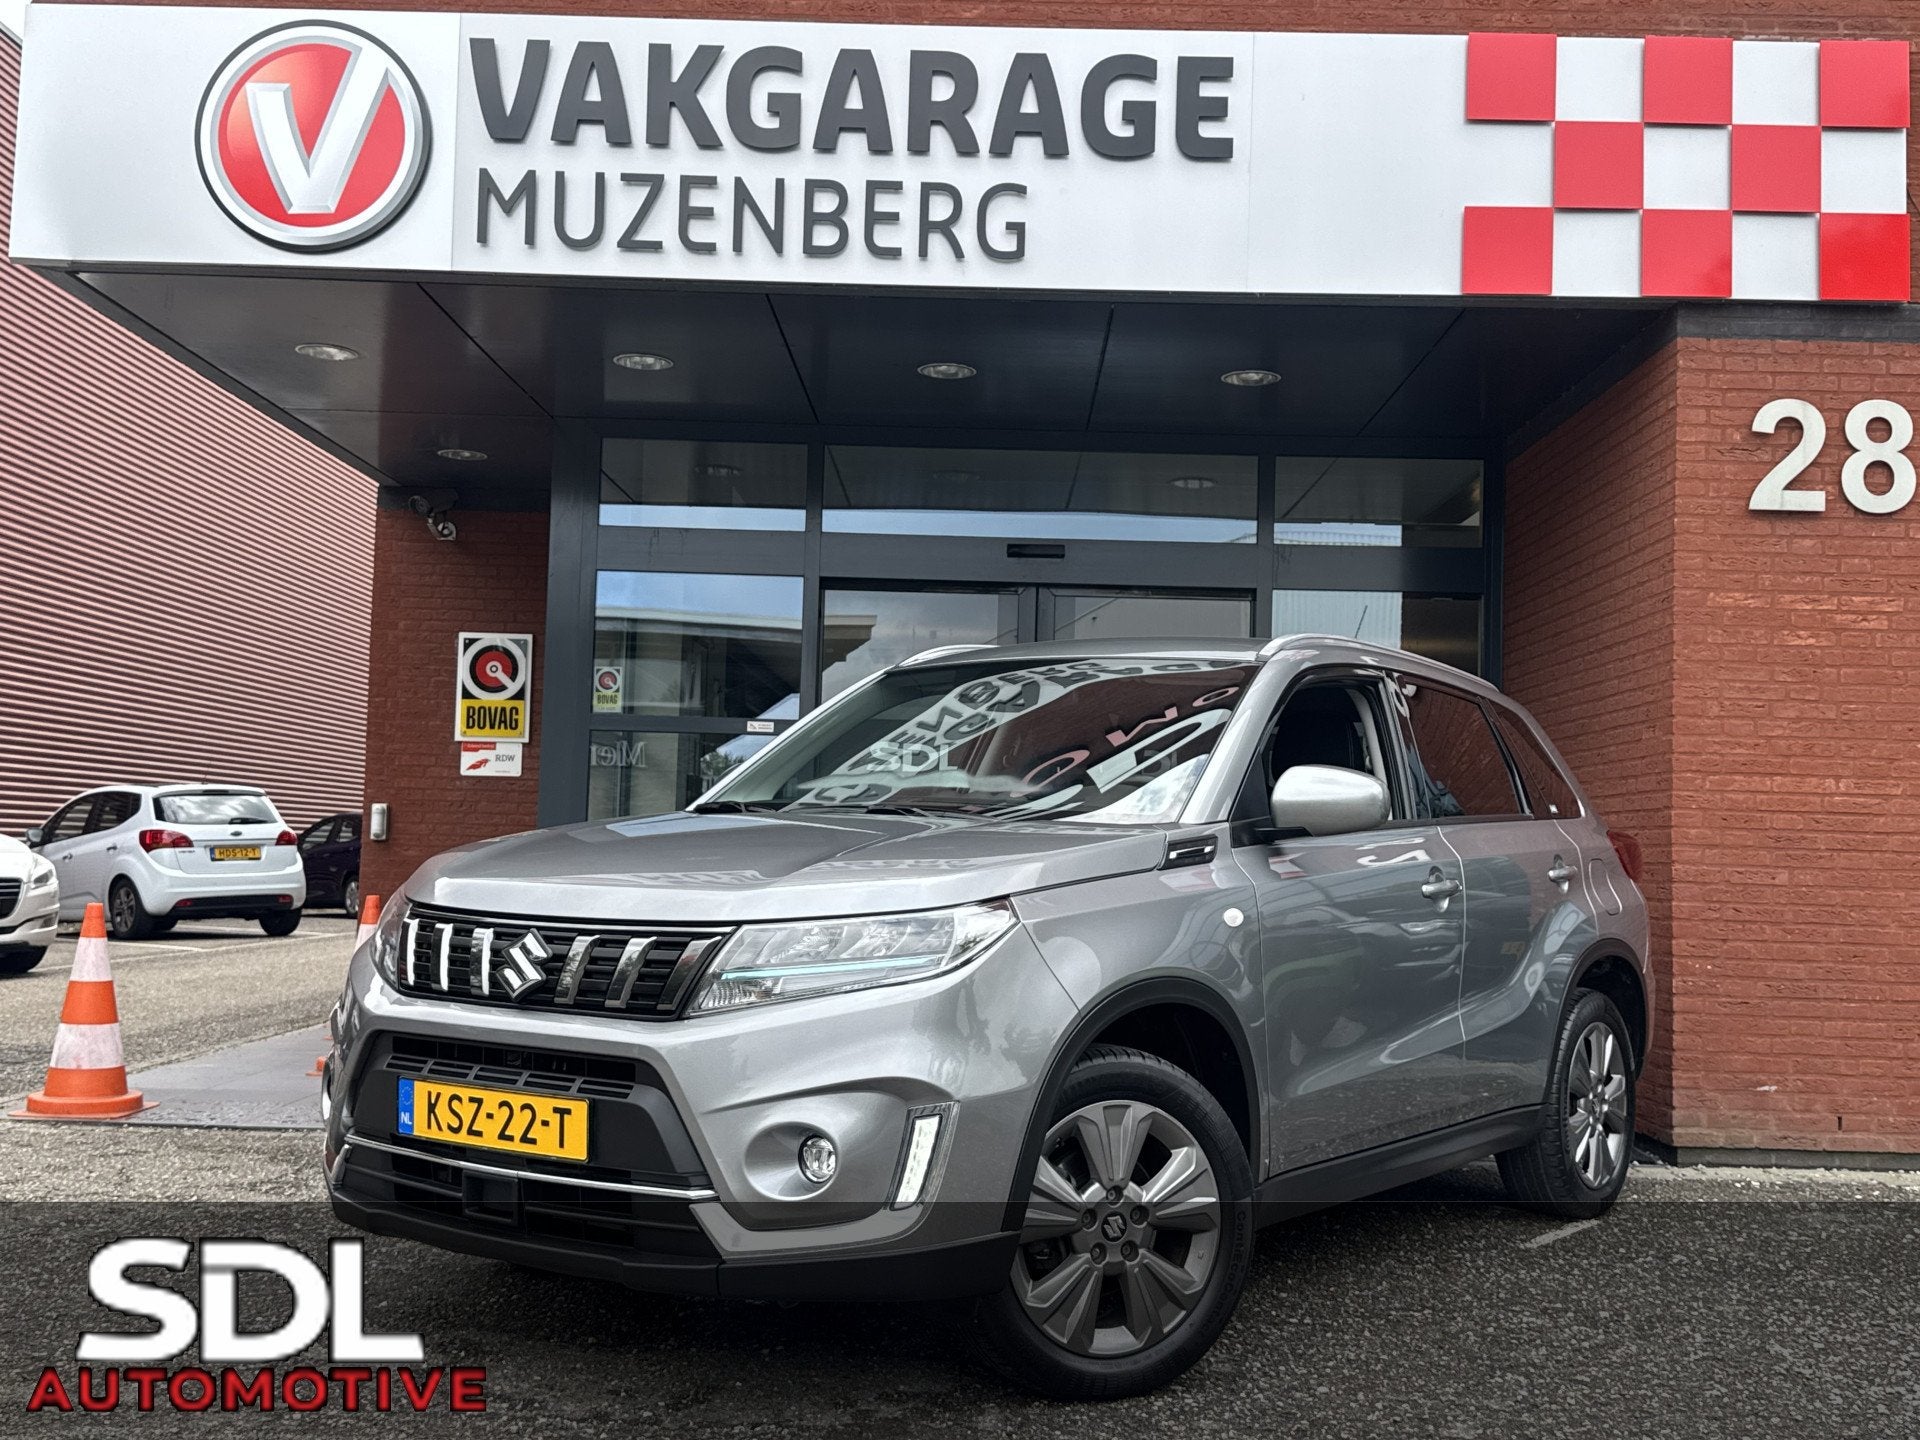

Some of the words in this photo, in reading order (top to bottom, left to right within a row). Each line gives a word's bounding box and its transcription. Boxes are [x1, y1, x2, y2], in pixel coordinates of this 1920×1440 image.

[469, 37, 1235, 161] VAKGARAGE
[476, 166, 1028, 262] MUZENBERG
[1748, 398, 1917, 514] 28
[597, 694, 618, 705] BOVAG
[466, 705, 519, 731] BOVAG
[494, 754, 516, 763] RDW
[866, 741, 958, 772] SDL
[400, 1112, 412, 1126] NL
[426, 1090, 572, 1149] KSZ-22-T
